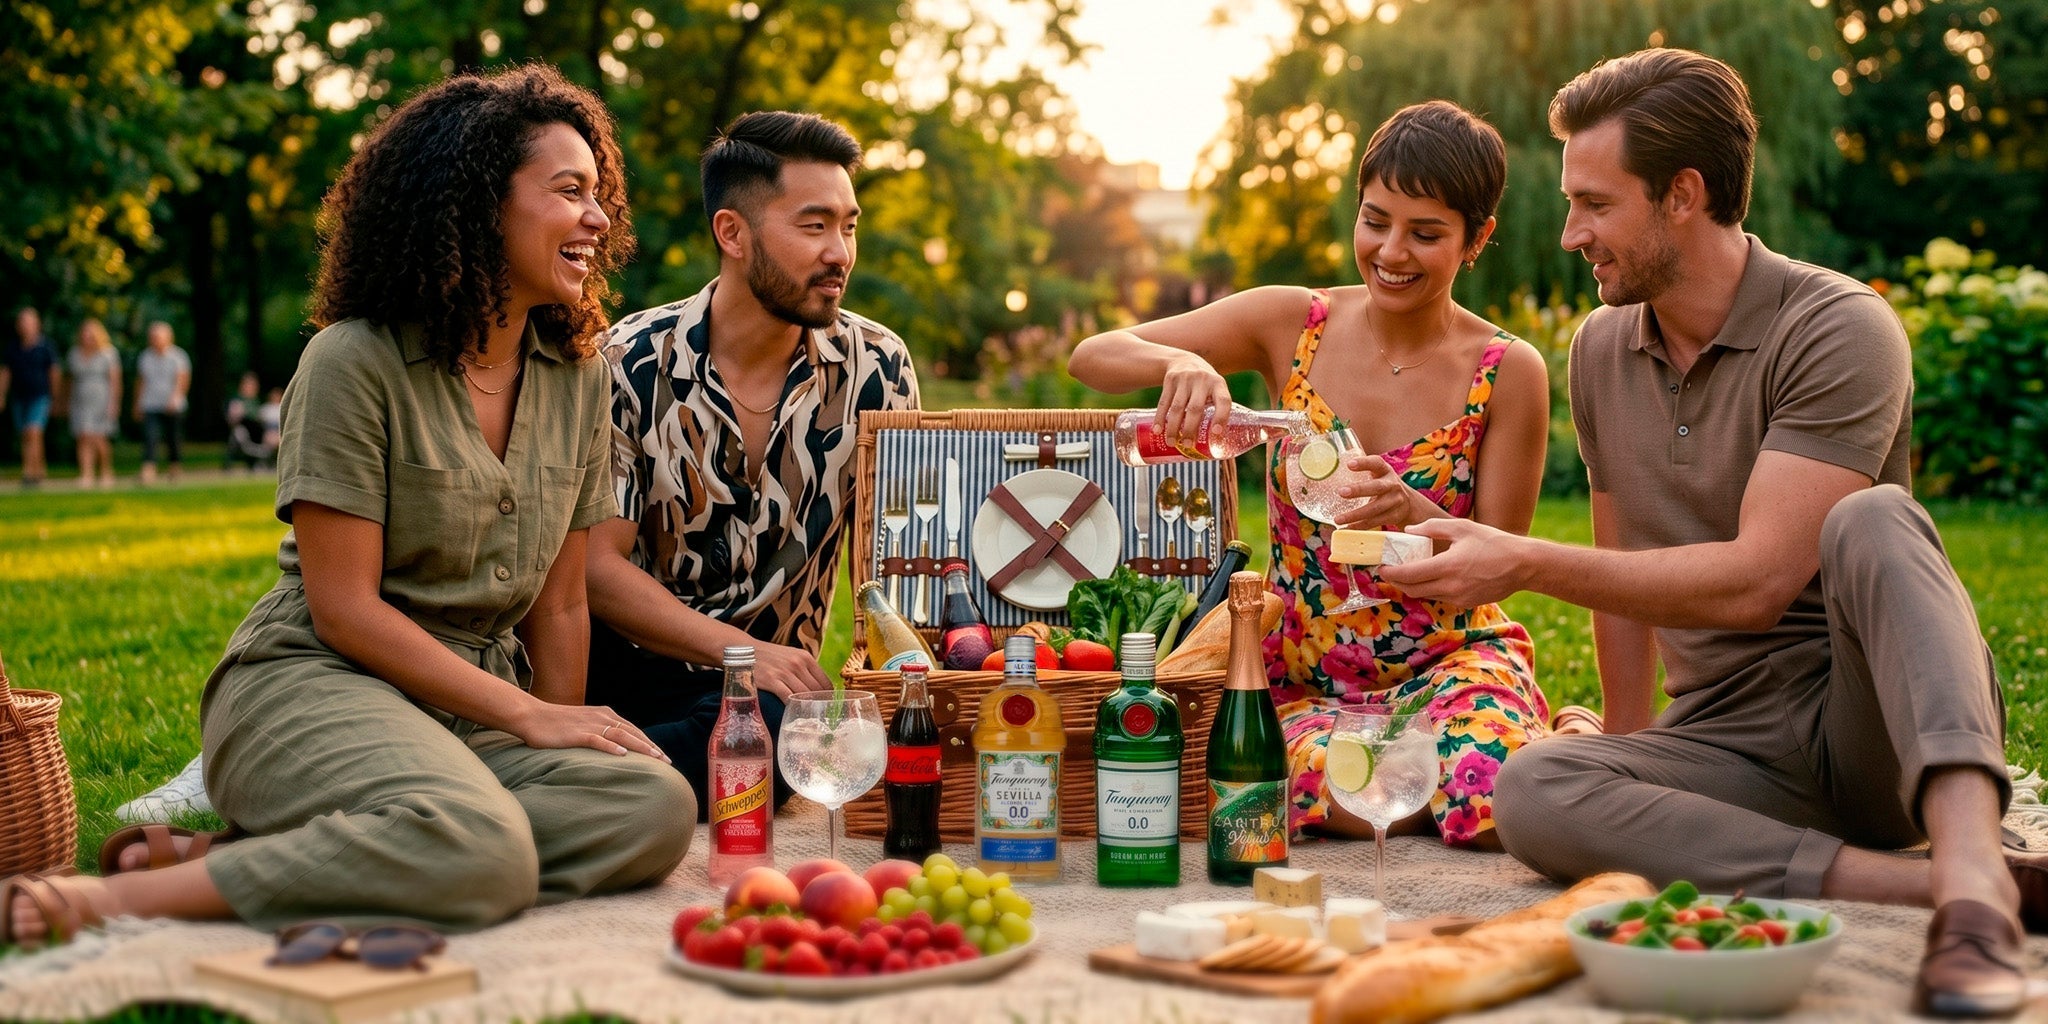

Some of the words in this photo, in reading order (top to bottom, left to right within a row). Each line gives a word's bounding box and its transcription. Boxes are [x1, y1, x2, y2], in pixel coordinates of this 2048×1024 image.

[991, 772, 1048, 787] Tanqueray
[716, 785, 768, 817] Schweppes
[996, 790, 1042, 800] SEVILLA
[1105, 789, 1172, 809] Tanqueray
[1009, 805, 1029, 819] 0.0
[1128, 816, 1149, 830] 0.0
